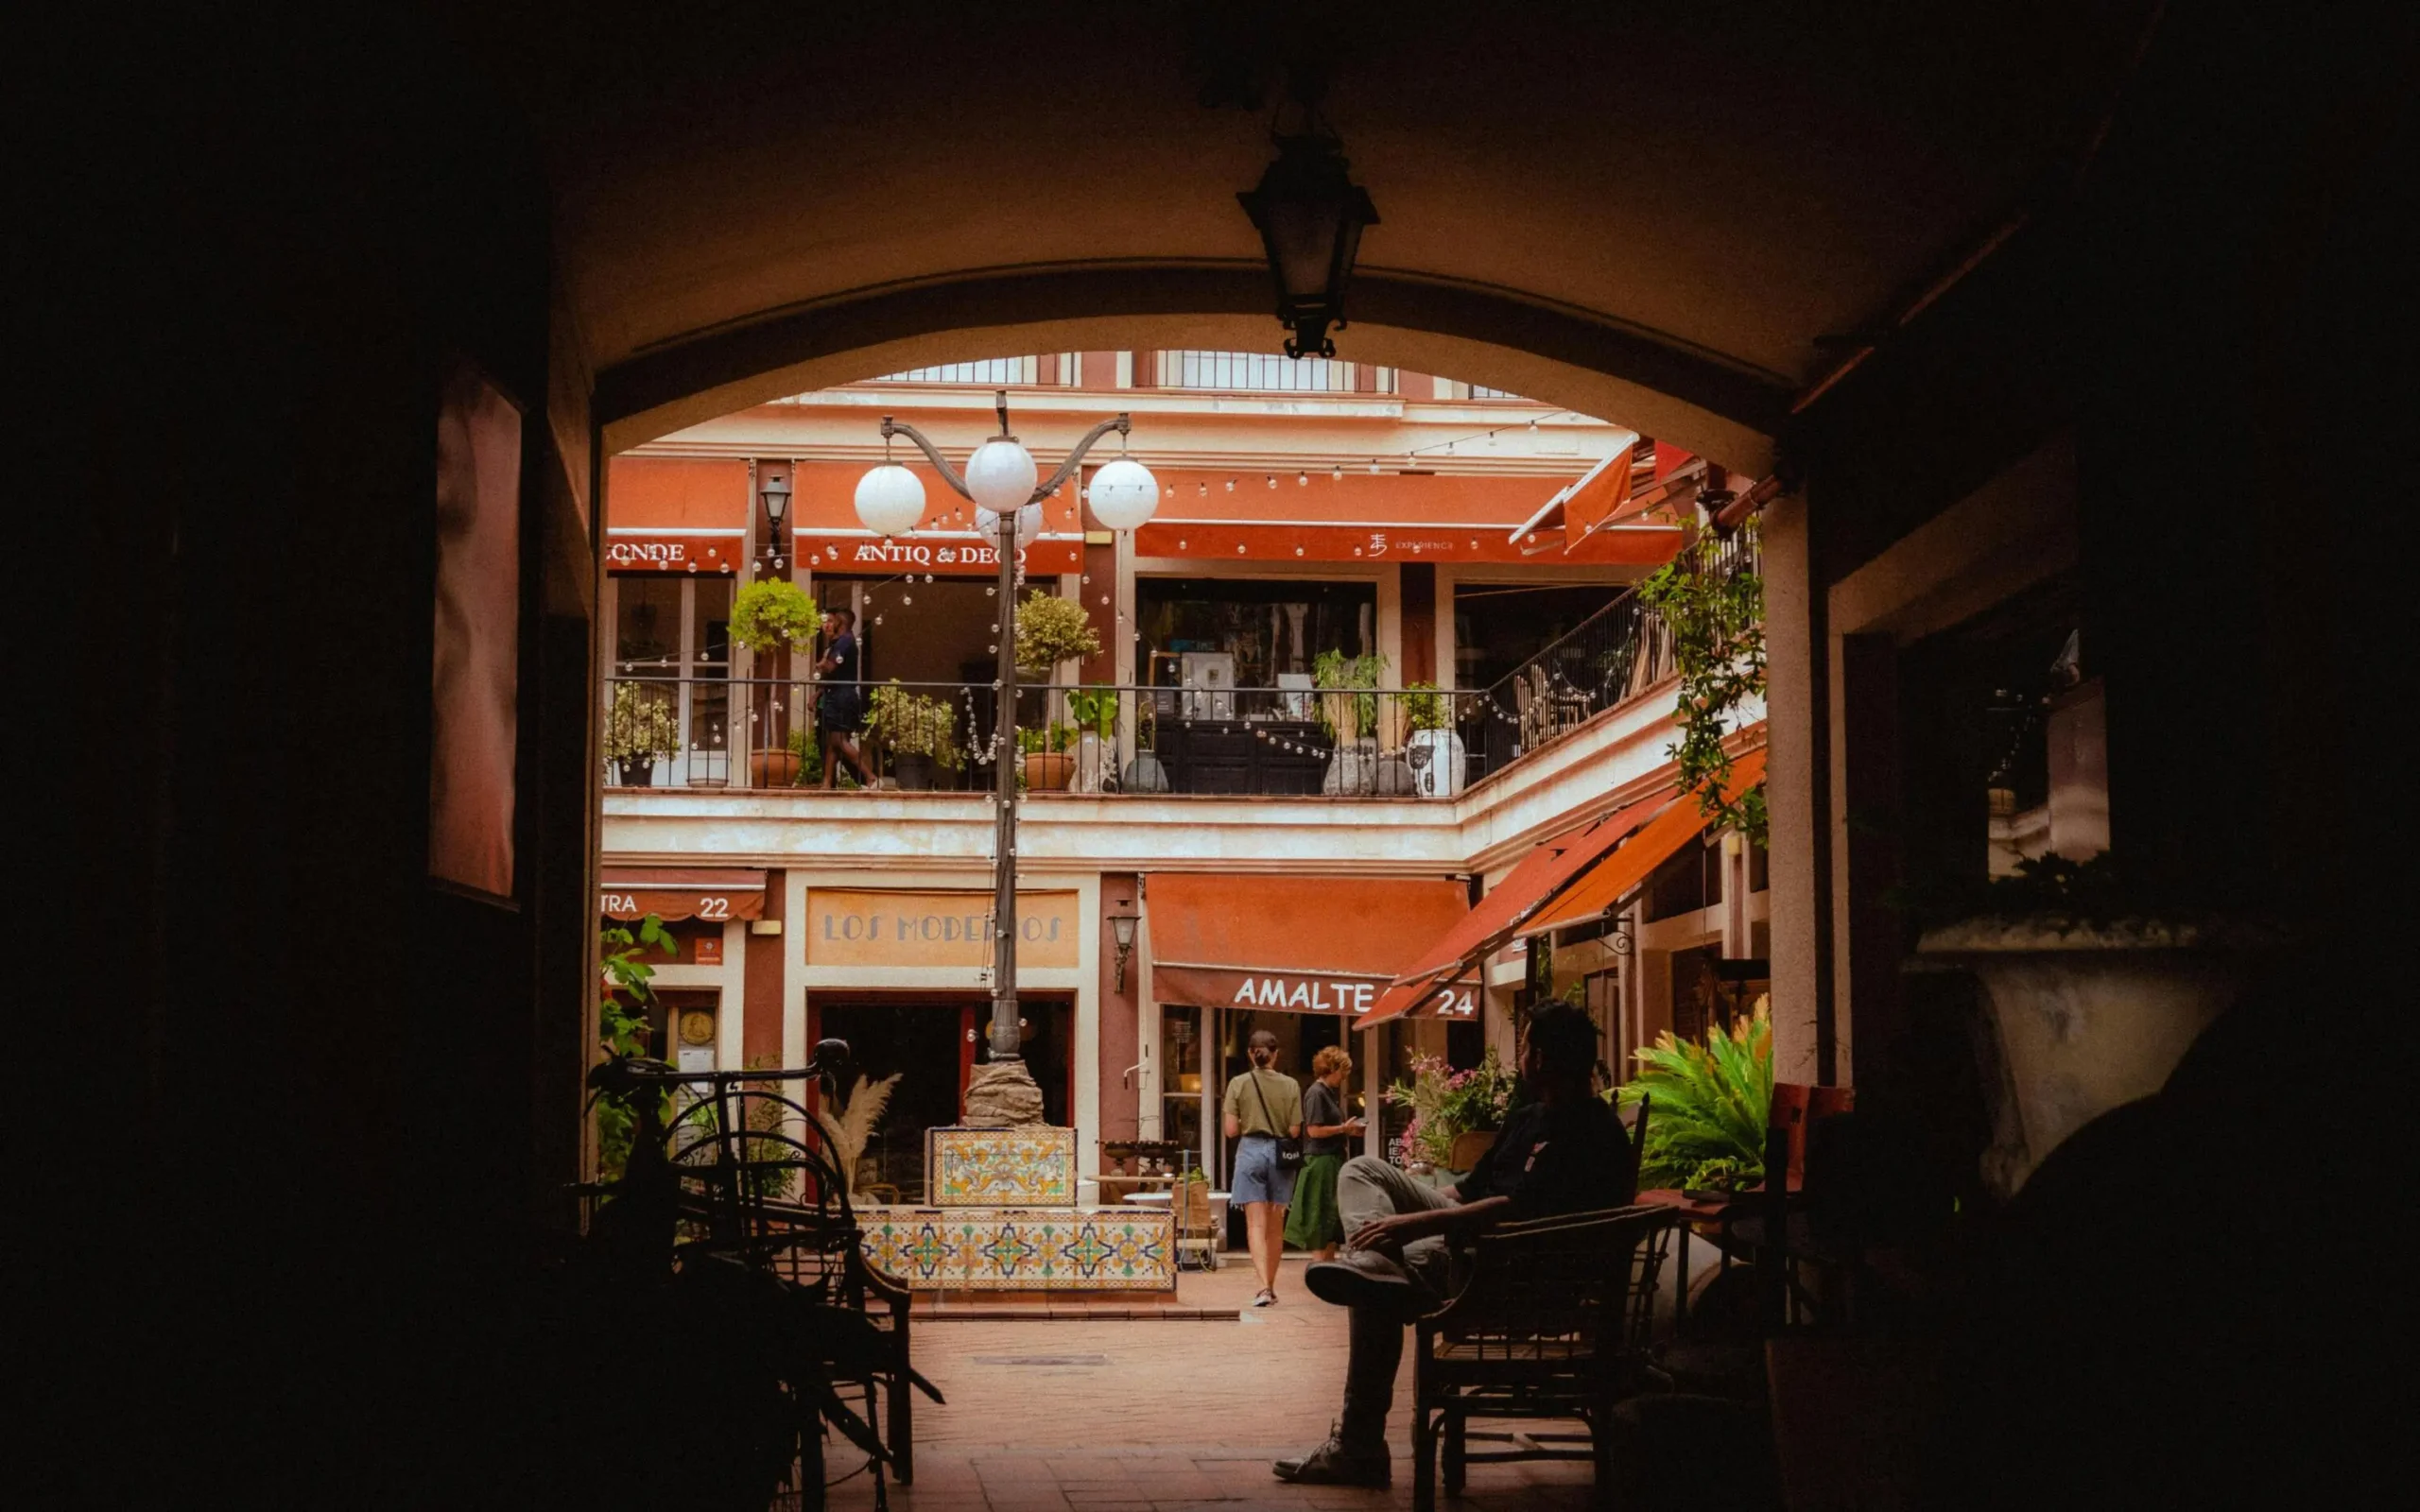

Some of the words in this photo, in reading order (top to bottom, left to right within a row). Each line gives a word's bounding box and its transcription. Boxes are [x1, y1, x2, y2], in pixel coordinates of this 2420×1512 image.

[606, 543, 684, 560] ONDE
[855, 545, 931, 565] ANTIQ
[937, 547, 958, 563] &
[700, 898, 729, 918] 22
[824, 915, 882, 941] LOS
[898, 916, 1063, 942] MODEOS
[1436, 989, 1474, 1015] 24
